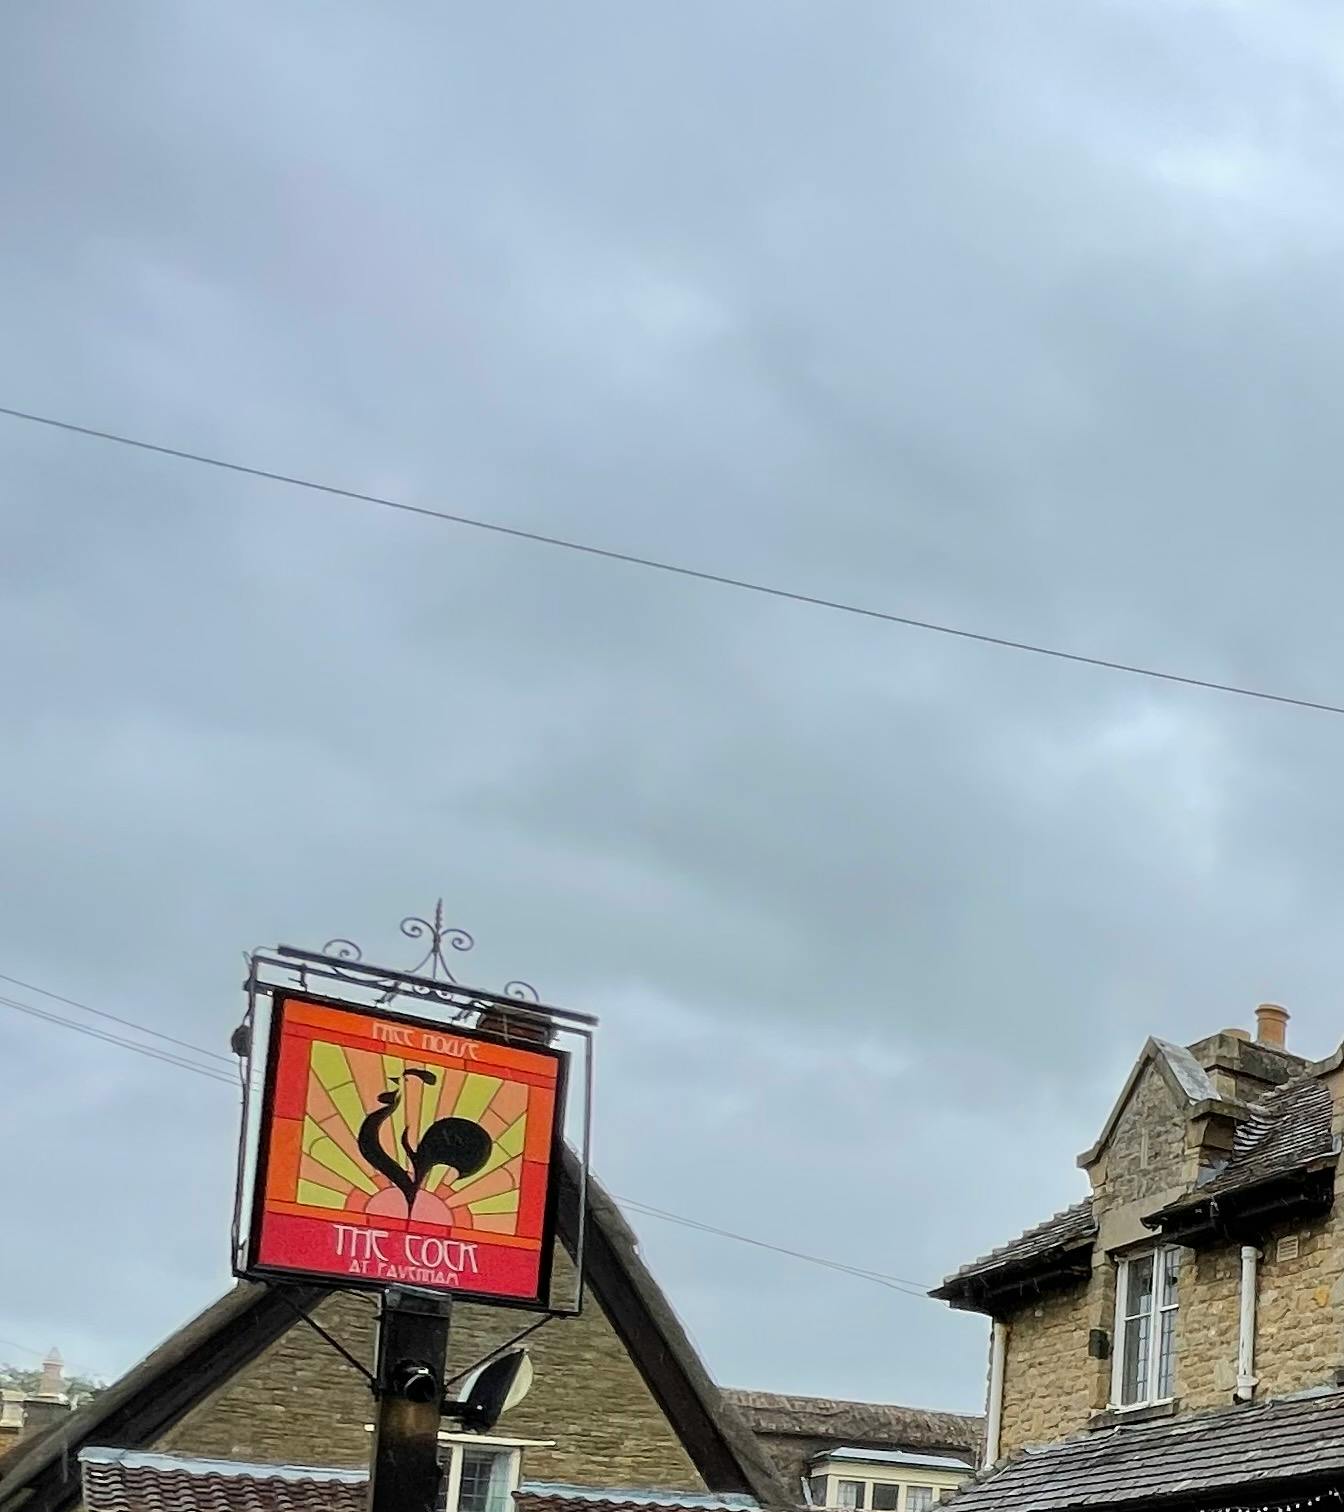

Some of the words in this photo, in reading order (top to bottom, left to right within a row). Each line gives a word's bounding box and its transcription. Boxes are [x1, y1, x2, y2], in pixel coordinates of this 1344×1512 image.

[333, 1224, 389, 1262] THE
[404, 1234, 479, 1274] COCK
[348, 1259, 371, 1274] AT
